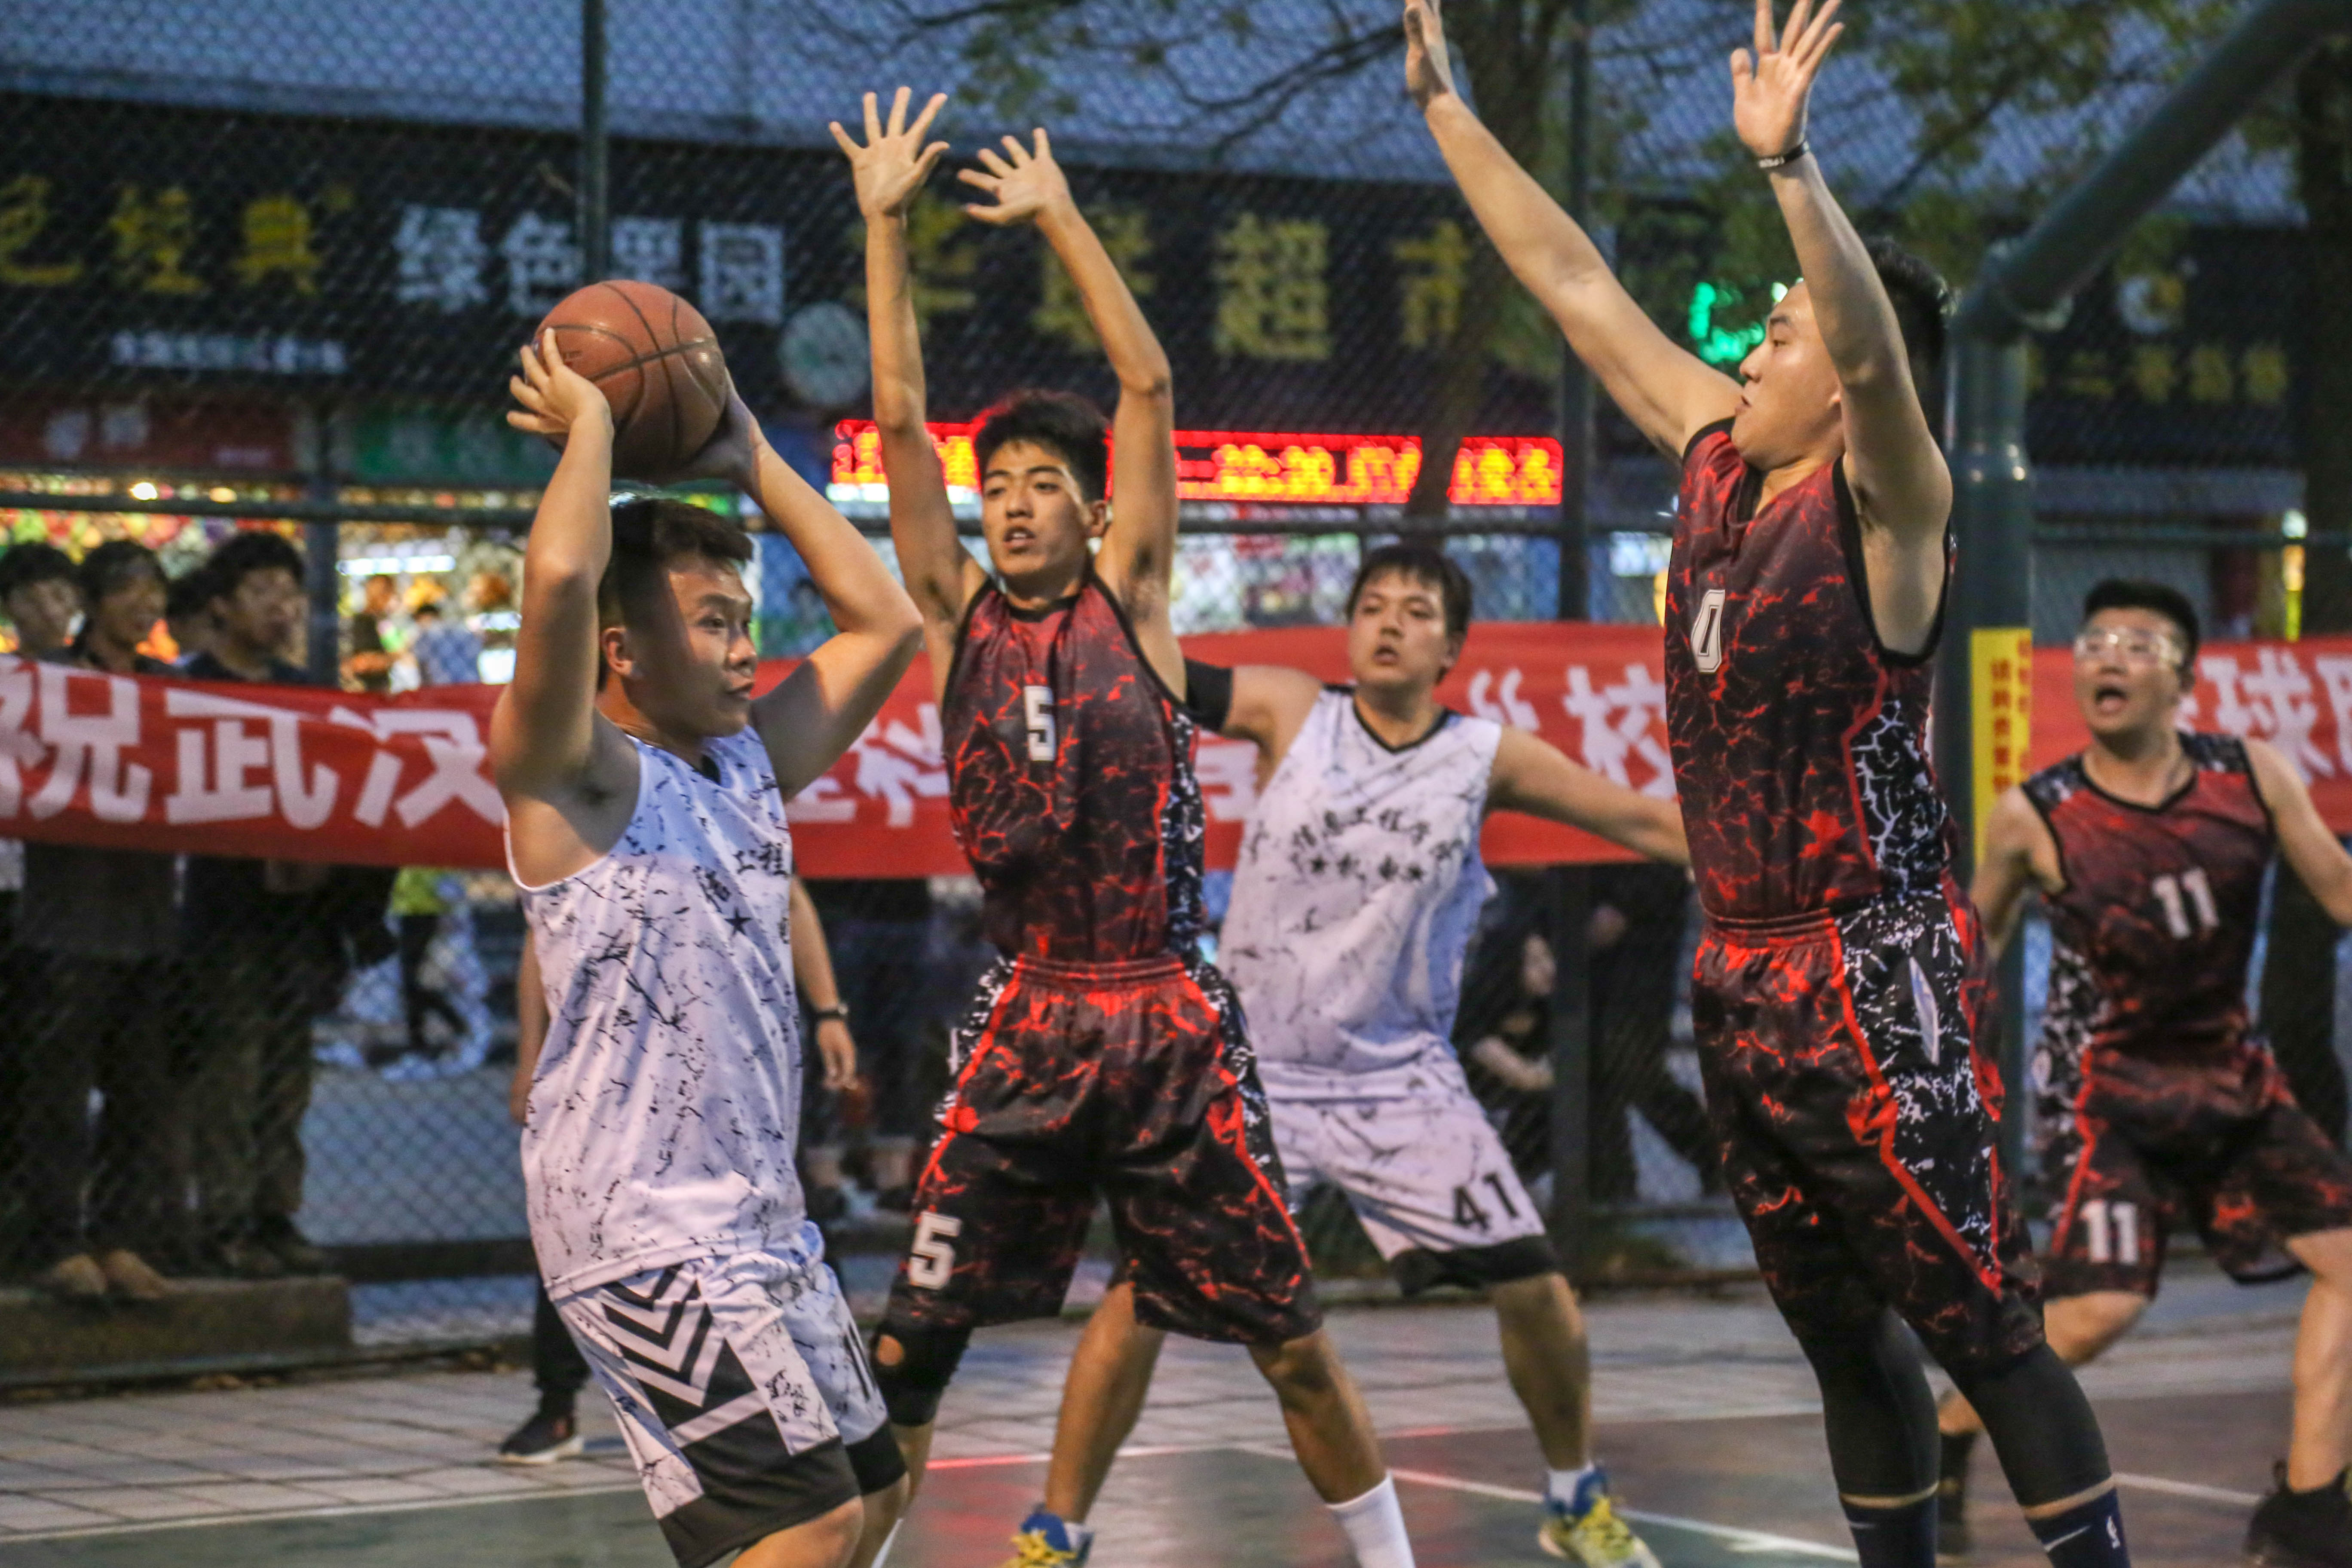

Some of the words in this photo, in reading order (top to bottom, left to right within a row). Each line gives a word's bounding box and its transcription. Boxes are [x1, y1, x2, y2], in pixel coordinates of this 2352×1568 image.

[1691, 589, 1725, 673] 0
[1024, 686, 1057, 761] 5
[2153, 867, 2220, 939] 11
[1453, 1170, 1522, 1234] 41
[2081, 1198, 2139, 1265] 11
[907, 1210, 963, 1291] 5
